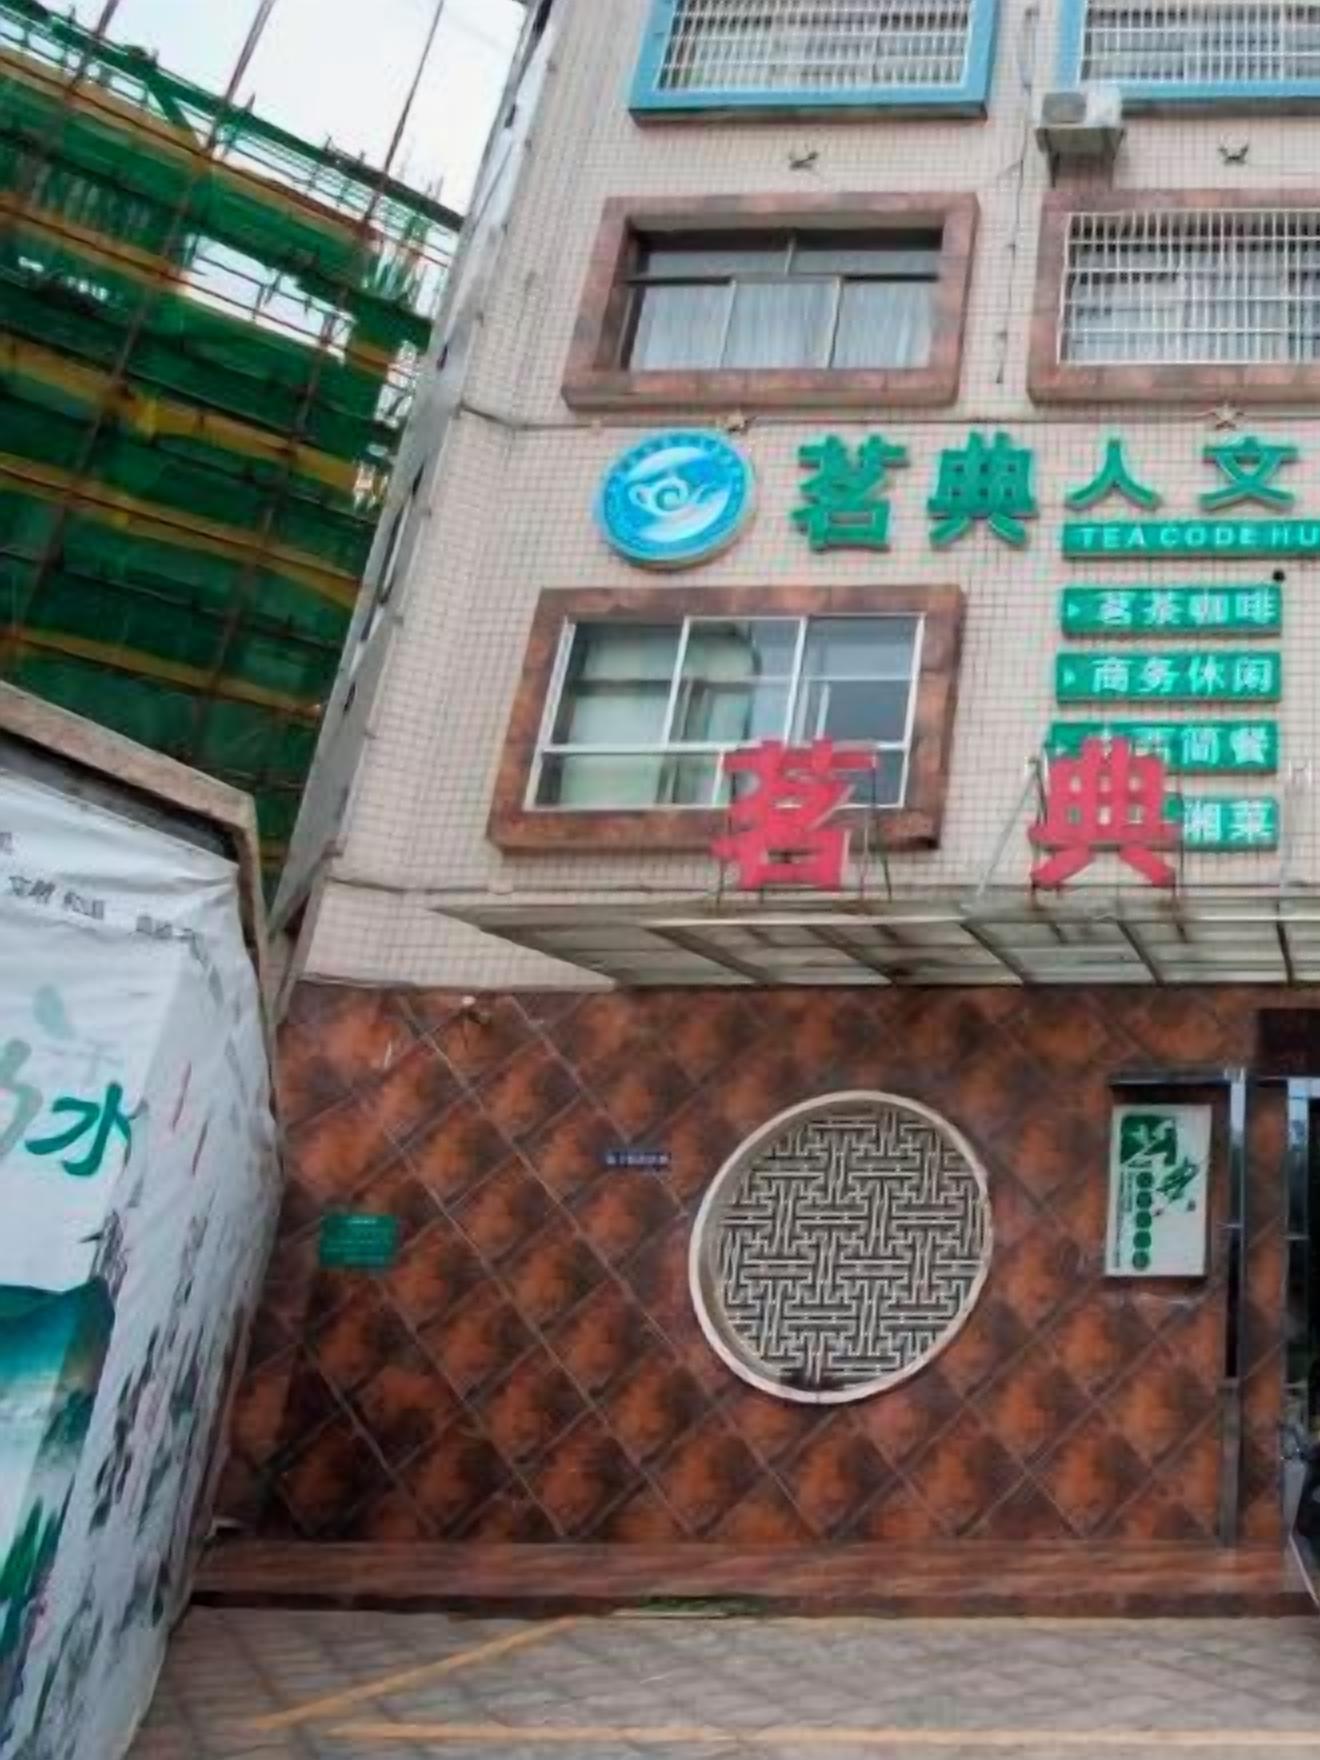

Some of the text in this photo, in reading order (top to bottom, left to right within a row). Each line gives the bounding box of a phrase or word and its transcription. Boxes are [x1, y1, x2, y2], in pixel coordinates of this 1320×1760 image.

[1081, 527, 1146, 549] TEA
[1159, 526, 1253, 546] CODE
[1091, 655, 1273, 693] 商务休闲
[1096, 727, 1269, 765] 西简餐
